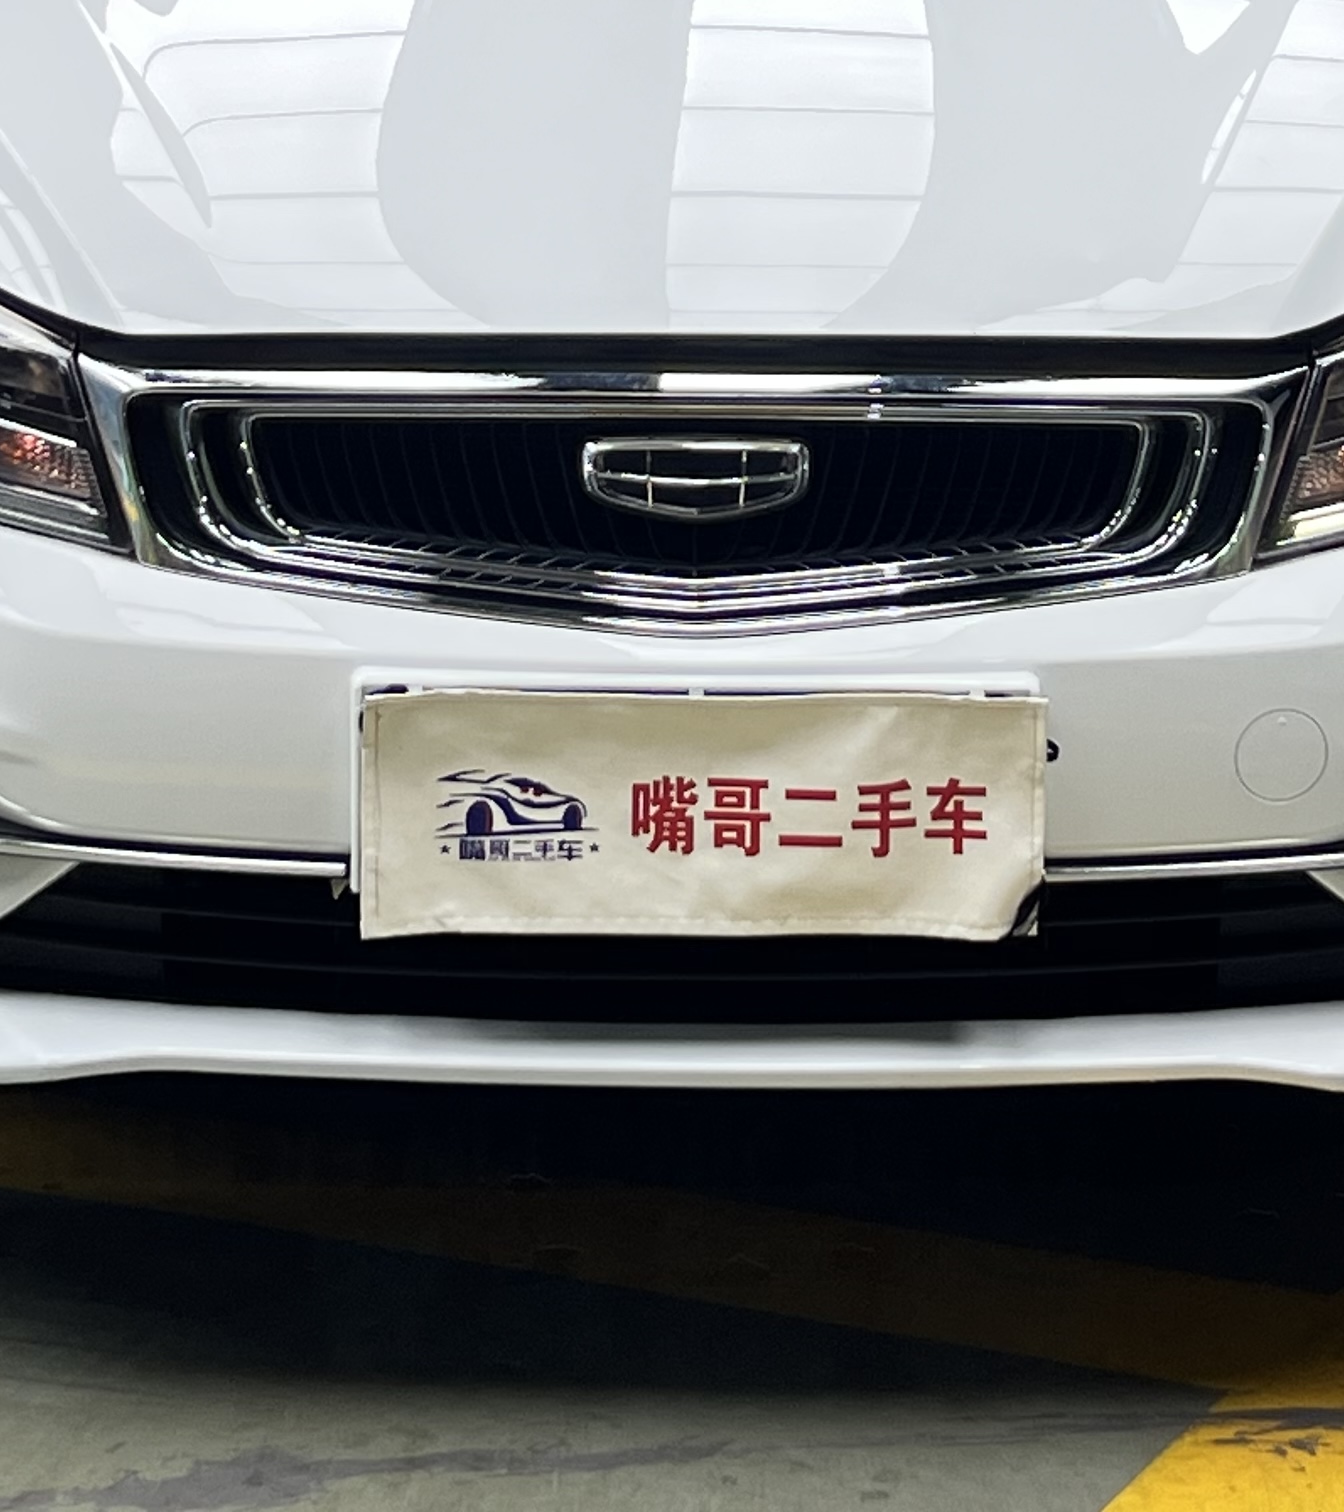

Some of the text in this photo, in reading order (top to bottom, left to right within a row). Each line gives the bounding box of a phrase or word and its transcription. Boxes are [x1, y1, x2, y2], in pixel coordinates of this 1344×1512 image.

[631, 776, 987, 857] 嘴哥二手车
[459, 839, 584, 861] 嘴哥二手车
